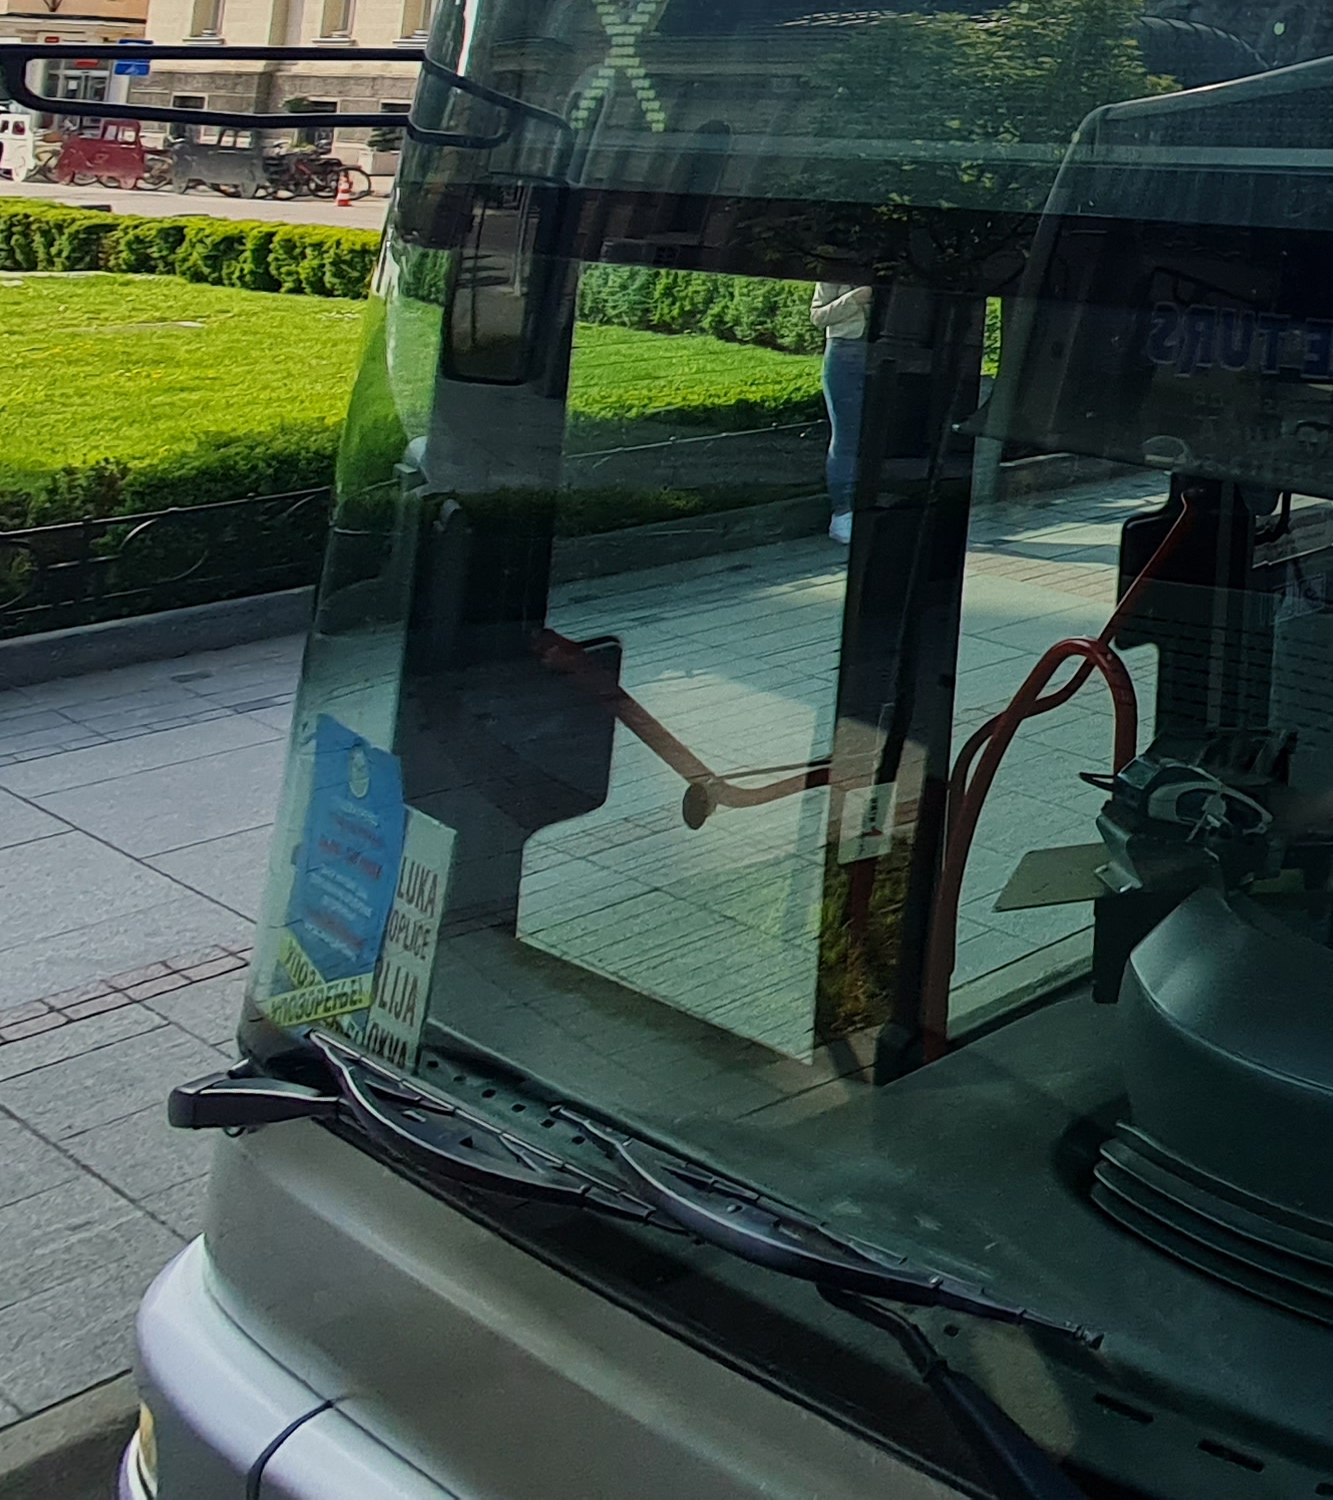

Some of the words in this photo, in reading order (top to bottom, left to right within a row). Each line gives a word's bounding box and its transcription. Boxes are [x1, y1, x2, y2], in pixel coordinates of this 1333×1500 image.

[397, 856, 438, 918] LUKA
[388, 909, 431, 960] OPLICE
[378, 960, 419, 1027] LIJA
